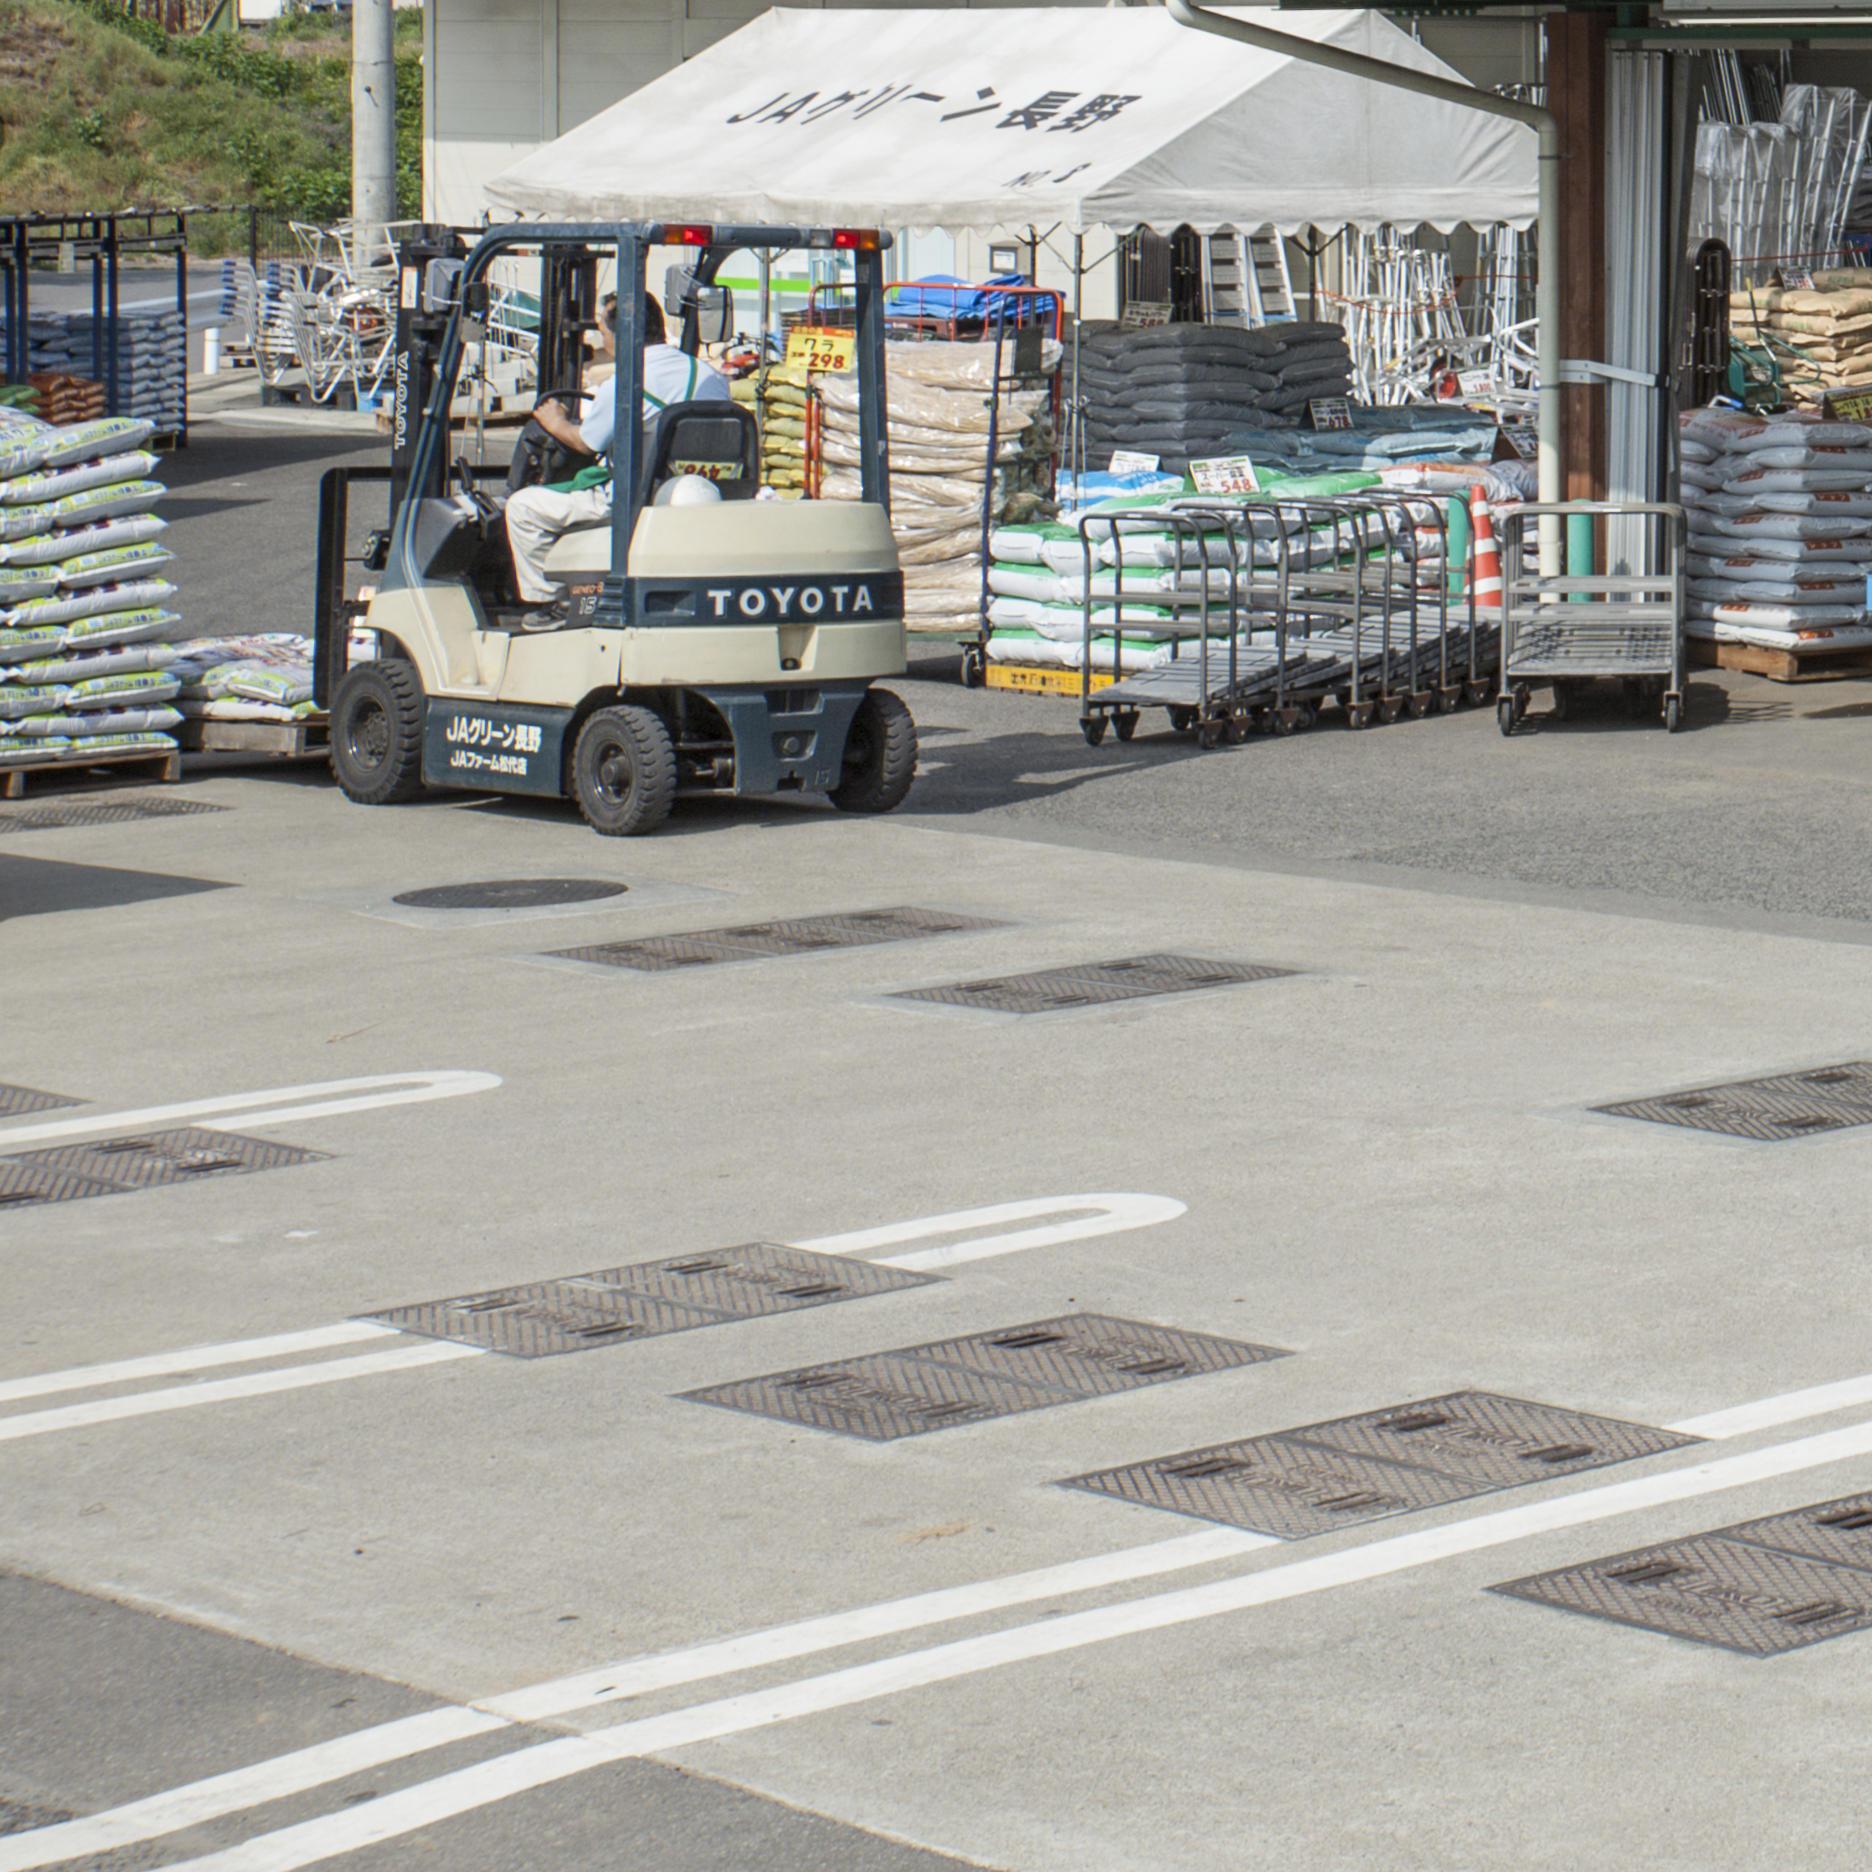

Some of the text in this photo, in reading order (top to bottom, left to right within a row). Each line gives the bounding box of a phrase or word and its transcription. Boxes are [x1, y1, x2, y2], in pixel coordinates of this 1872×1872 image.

[727, 80, 1143, 134] JAグリーン長野
[807, 352, 846, 369] 298
[394, 350, 410, 450] TOYOTA
[1220, 478, 1253, 494] 548
[707, 585, 874, 617] TOYOTA
[446, 715, 543, 754] JAグリーン長野
[450, 749, 529, 776] JAファーム松代店
